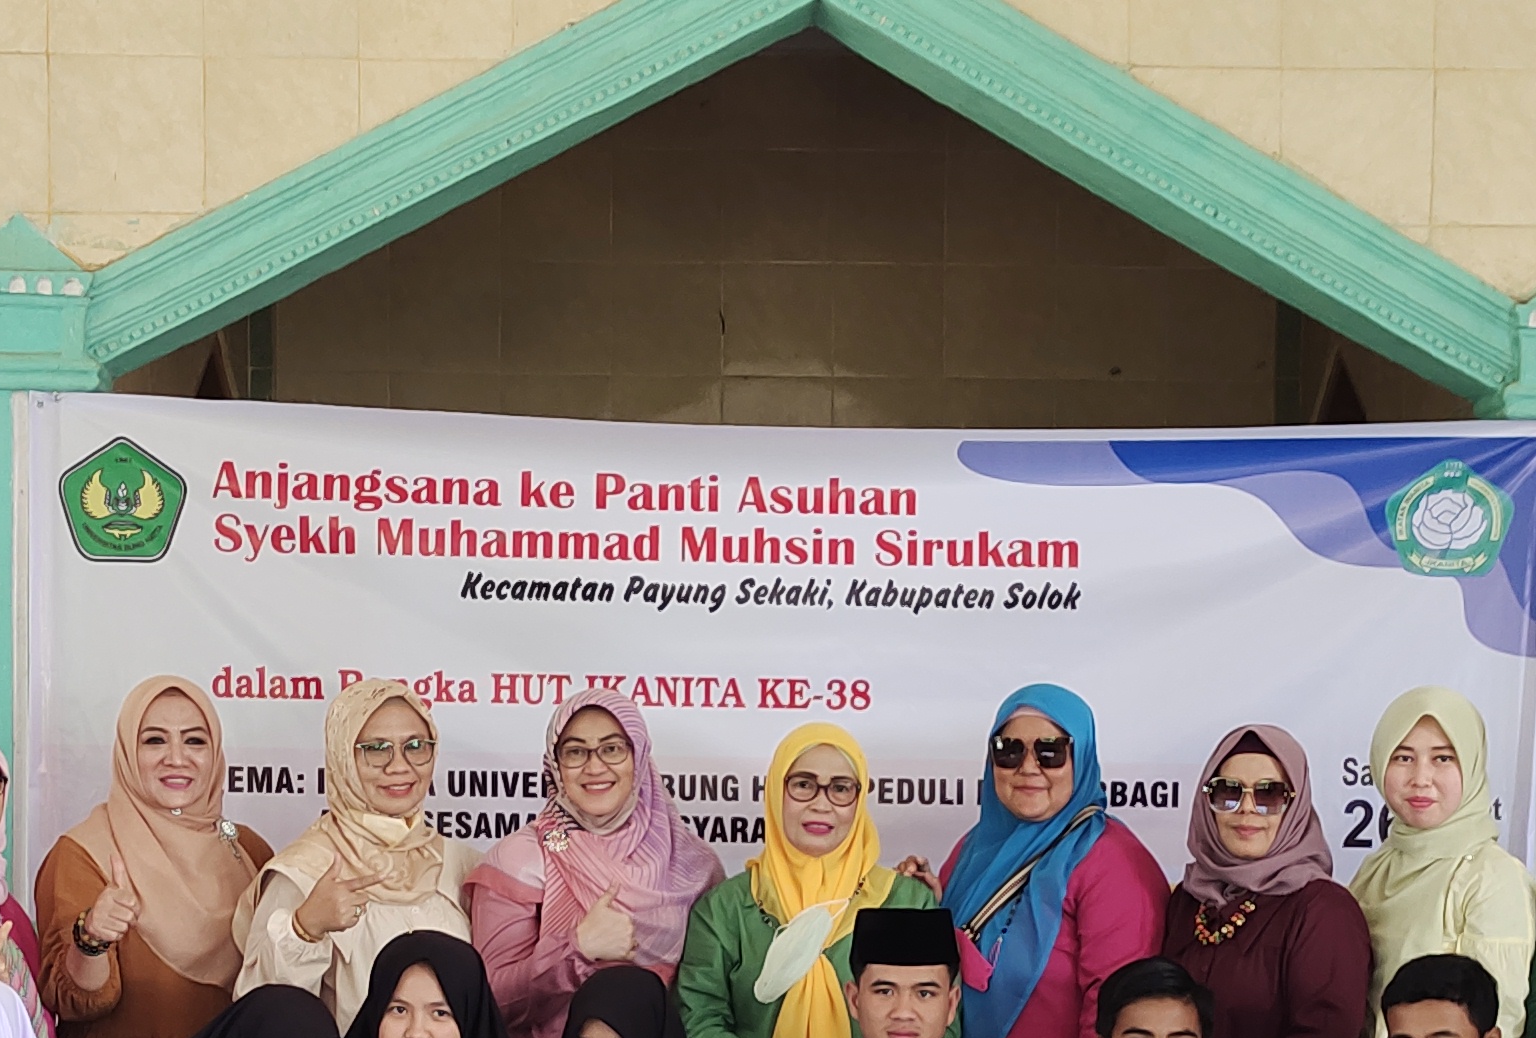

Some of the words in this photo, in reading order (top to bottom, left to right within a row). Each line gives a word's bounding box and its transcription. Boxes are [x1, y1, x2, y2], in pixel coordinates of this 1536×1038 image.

[213, 461, 501, 511] Anjangsana
[521, 471, 575, 508] ke
[595, 473, 719, 513] Panti
[737, 476, 917, 515] Asuhan
[214, 513, 356, 562] Syekh
[376, 517, 660, 561] Muhammad
[681, 526, 855, 565] Muhsin
[874, 529, 1079, 568] Sirukam
[460, 571, 614, 603] Kecamatan
[623, 575, 726, 613] Payung
[735, 577, 833, 610] Sekaki,
[844, 579, 995, 615] Kabupaten
[1003, 581, 1081, 611] Solok
[213, 666, 324, 700] dalam
[491, 672, 571, 705] HUT
[757, 678, 872, 711] KE-38
[227, 766, 306, 795] EMA:
